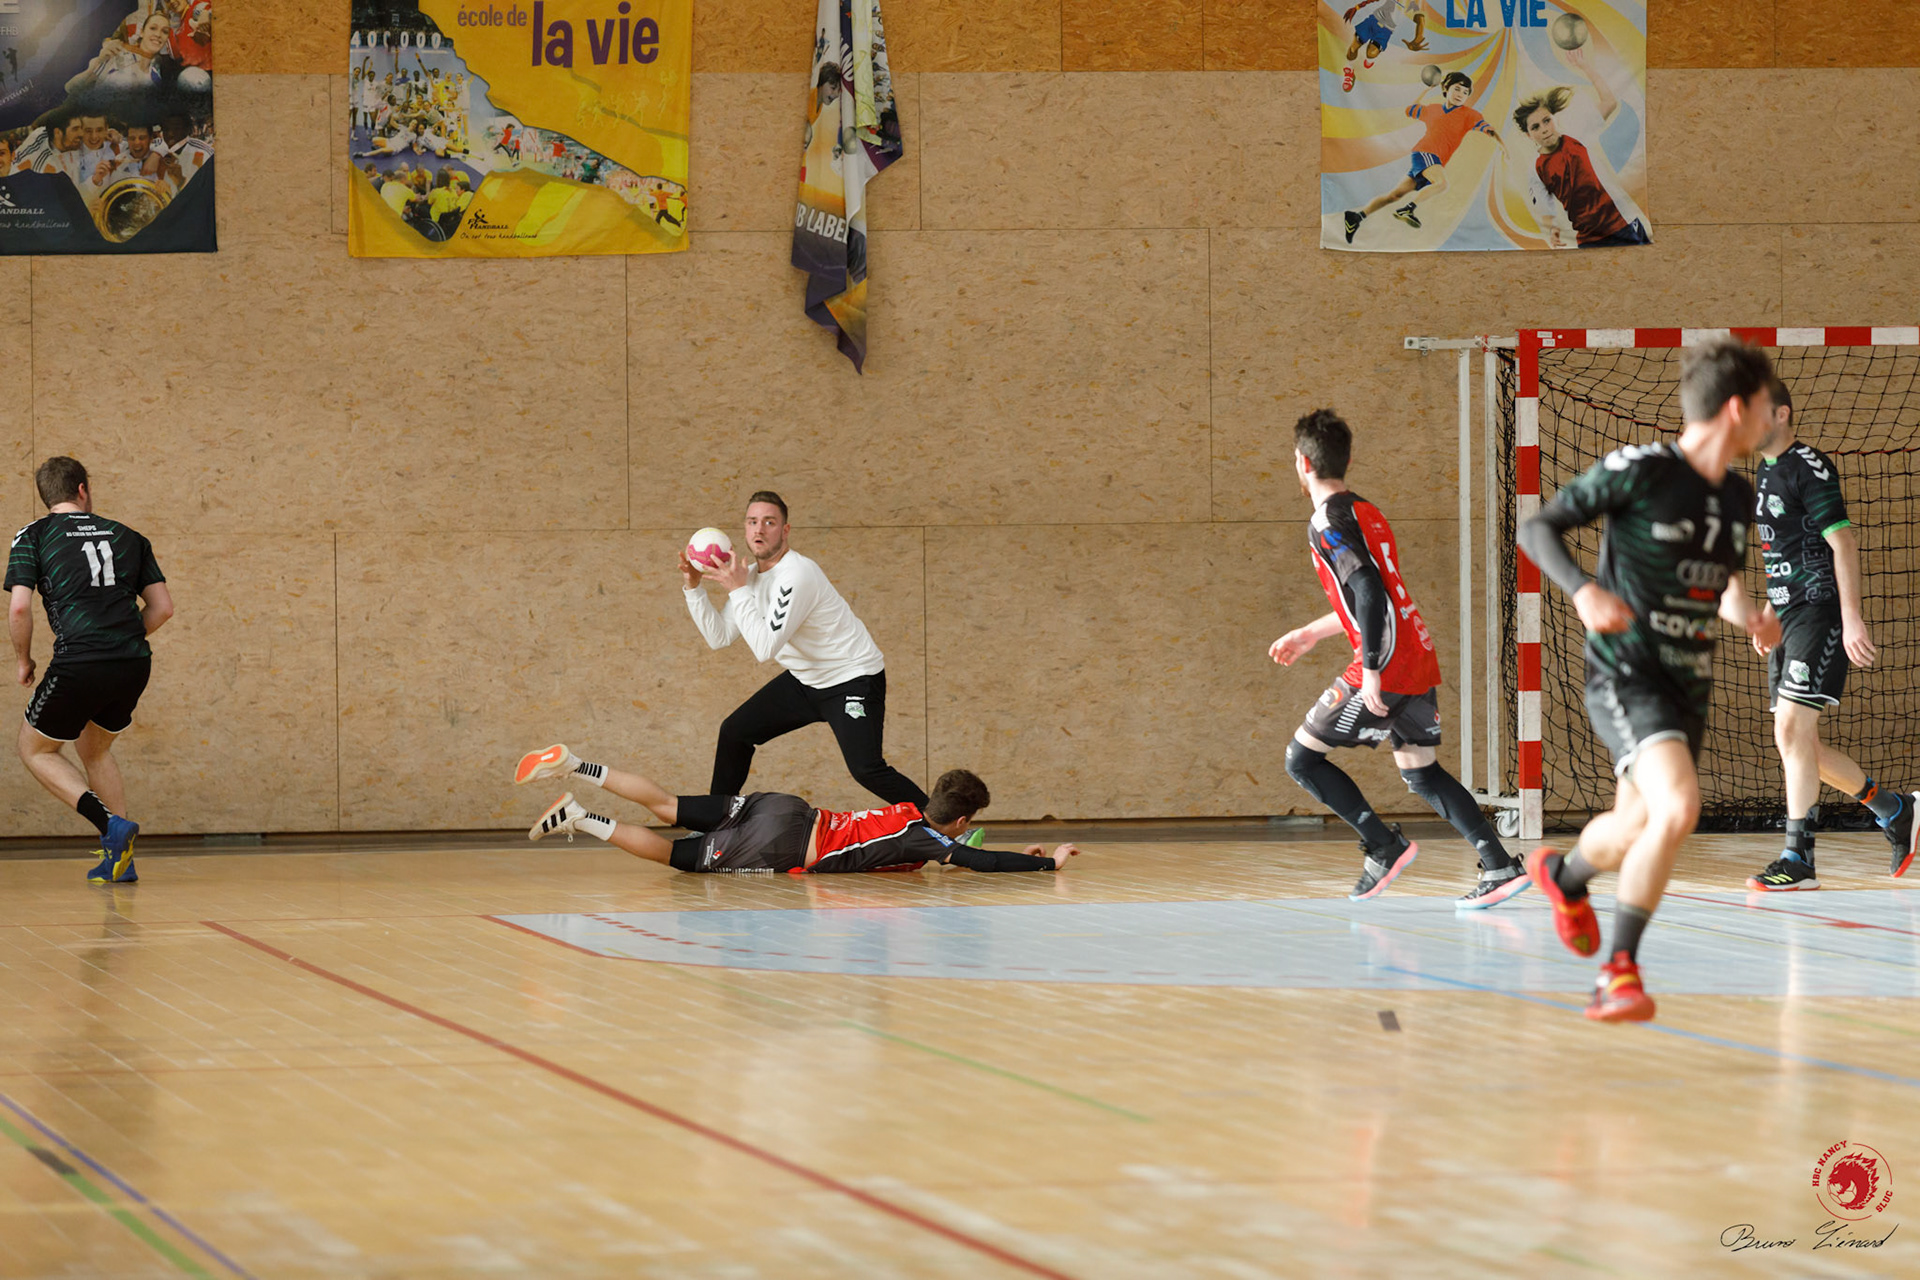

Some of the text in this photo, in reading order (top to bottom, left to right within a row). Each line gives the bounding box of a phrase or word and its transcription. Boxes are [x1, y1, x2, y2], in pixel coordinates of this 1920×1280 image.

[457, 4, 527, 26] école de
[1446, 0, 1548, 28] LA VIE
[532, 1, 660, 68] la vie
[0, 207, 45, 215] ANDBALL
[1702, 515, 1721, 553] 7
[81, 540, 116, 588] 11
